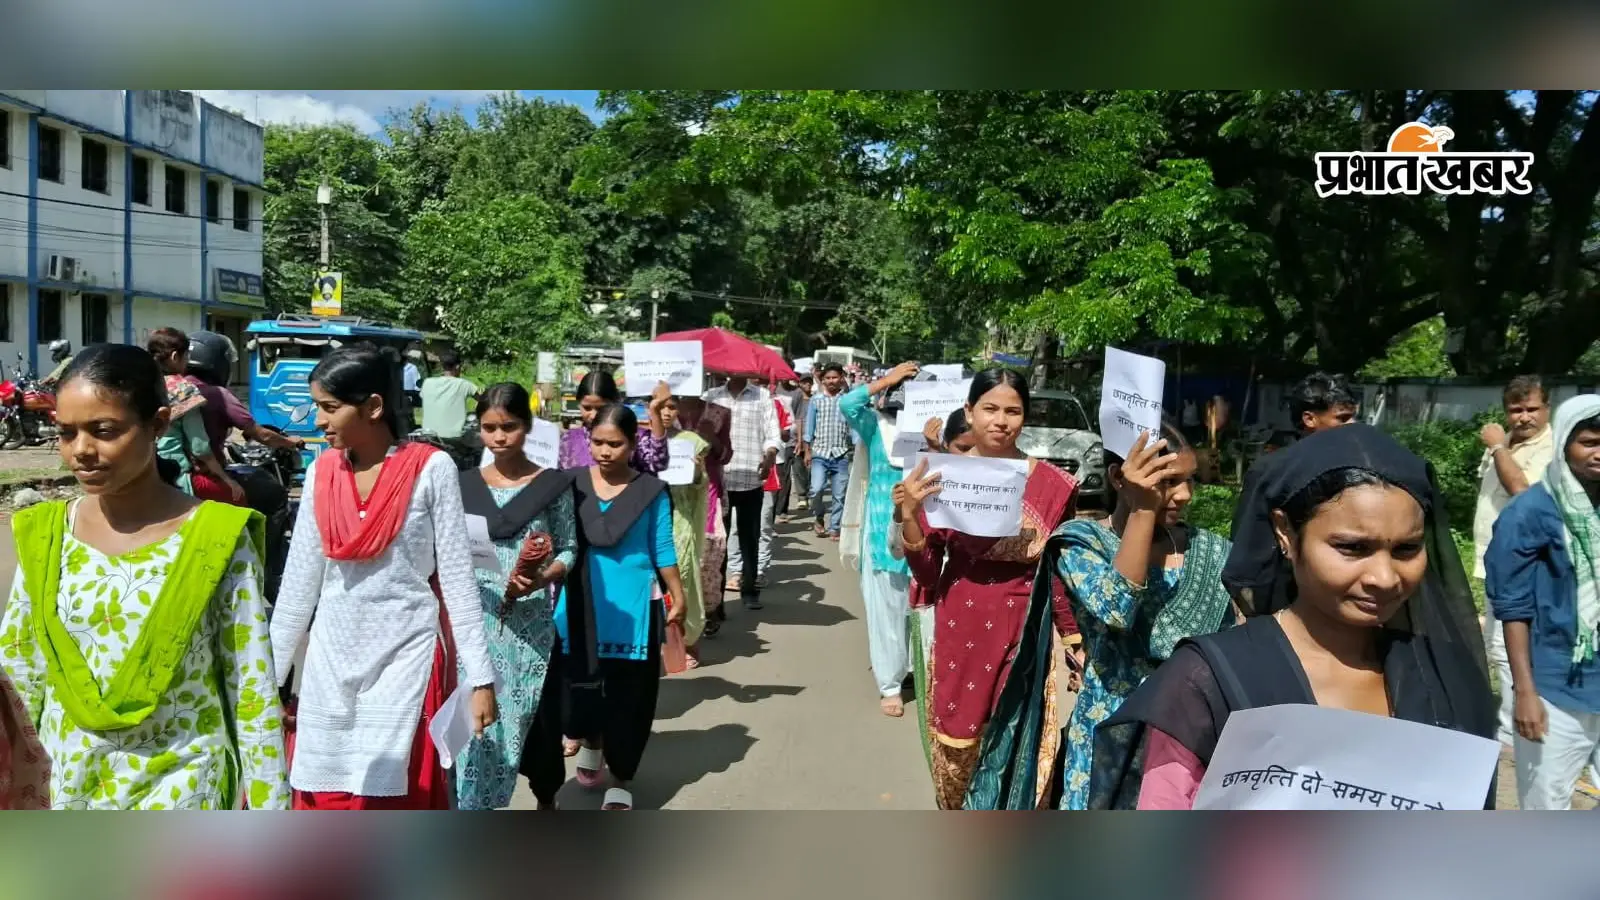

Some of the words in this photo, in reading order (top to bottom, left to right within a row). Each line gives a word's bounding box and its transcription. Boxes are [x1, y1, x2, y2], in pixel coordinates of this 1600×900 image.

[972, 483, 1001, 495] भुगतान
[963, 501, 992, 512] भुगतान
[1222, 764, 1299, 791] छात्रवृत्ति
